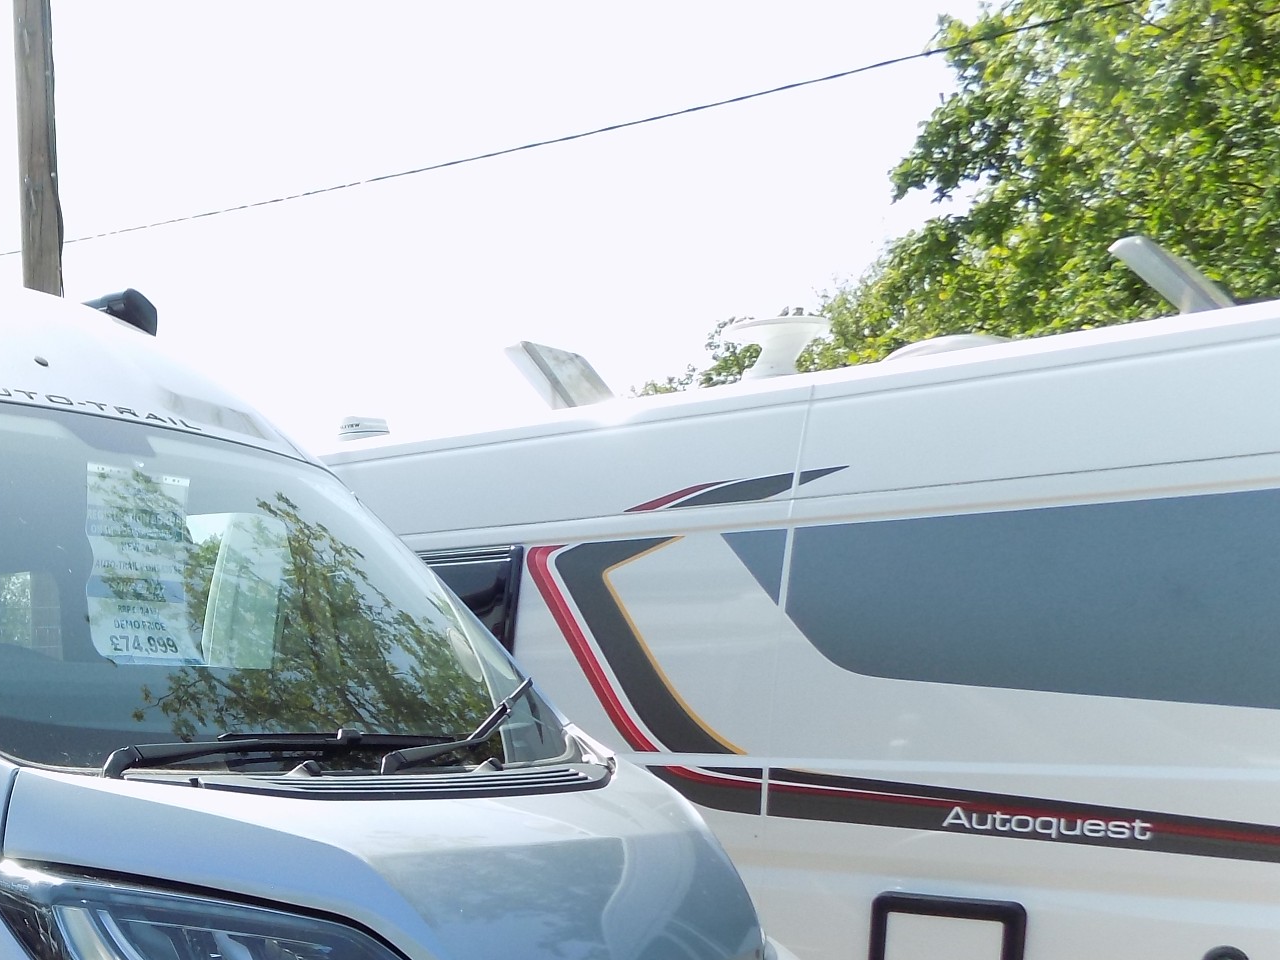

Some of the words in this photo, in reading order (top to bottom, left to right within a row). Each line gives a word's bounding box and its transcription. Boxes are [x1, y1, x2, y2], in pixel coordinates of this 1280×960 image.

[113, 618, 141, 630] DEMO
[141, 620, 167, 632] PRICE
[109, 634, 179, 655] £74,999
[942, 805, 1153, 841] Autoquest
